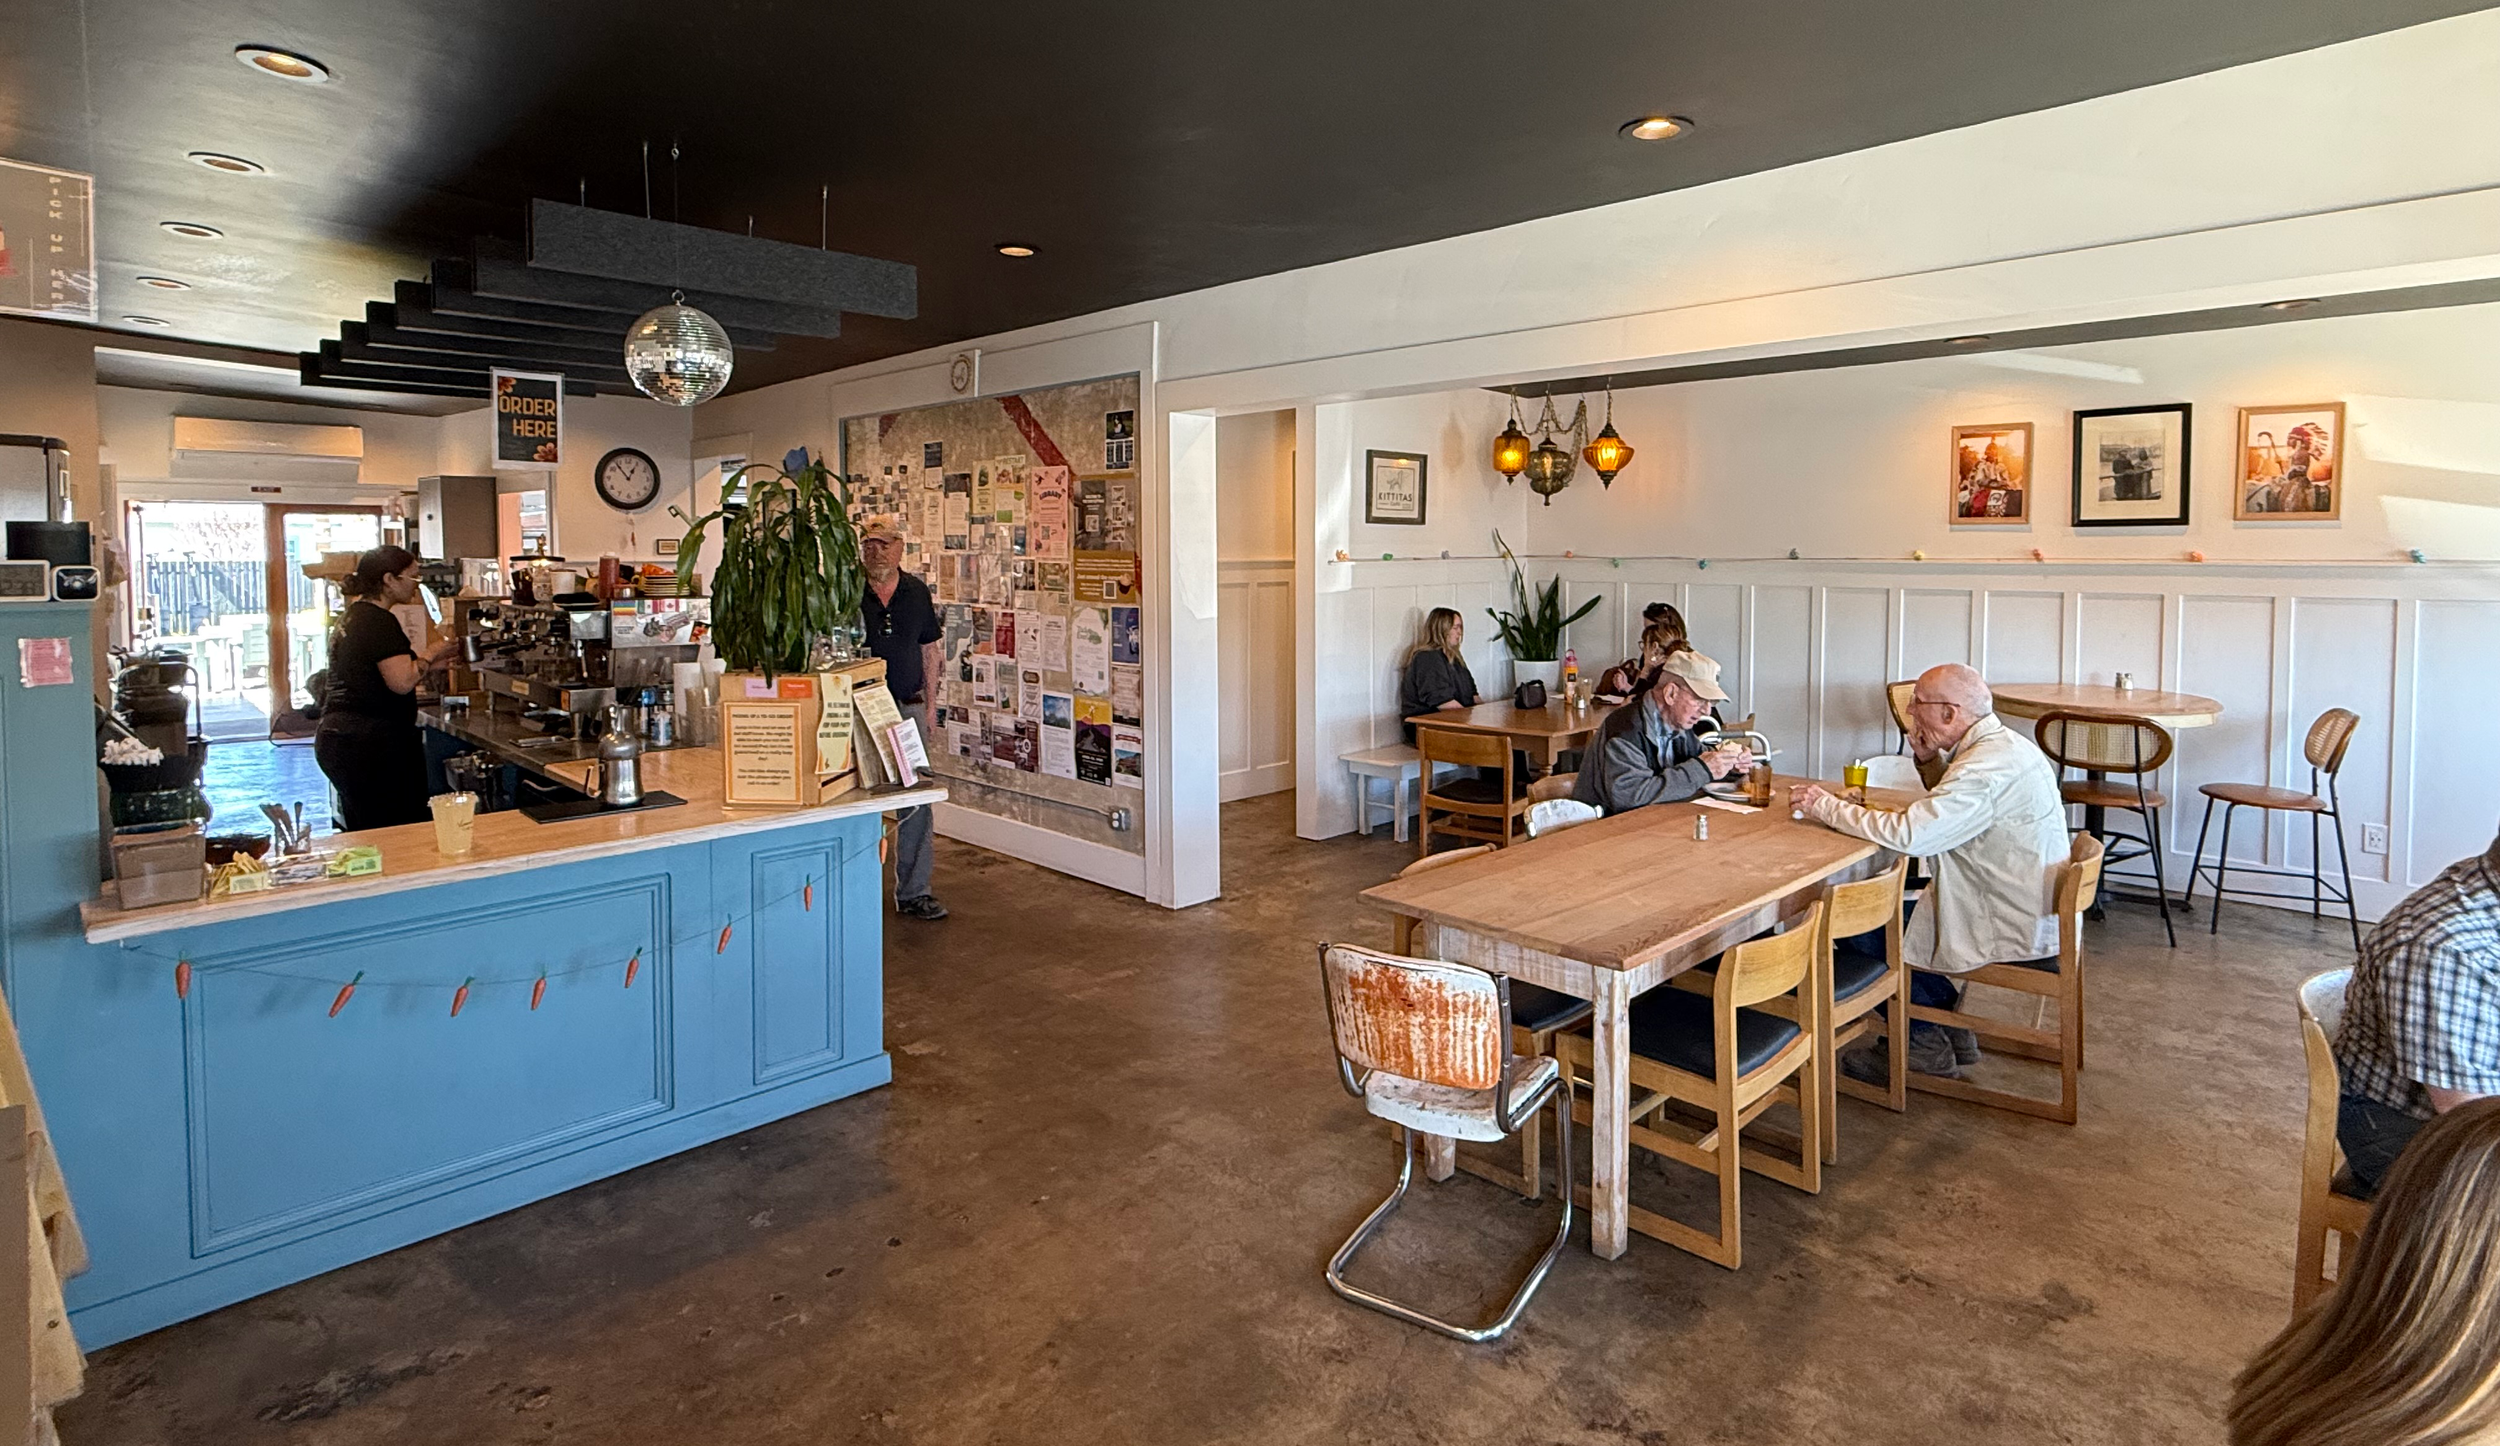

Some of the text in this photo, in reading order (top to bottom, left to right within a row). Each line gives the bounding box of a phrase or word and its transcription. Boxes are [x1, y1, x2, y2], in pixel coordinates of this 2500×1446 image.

[499, 395, 556, 417] ORDER
[512, 418, 556, 438] HERE
[1039, 490, 1062, 500] LIBRARY
[1379, 492, 1413, 502] KITTITAS
